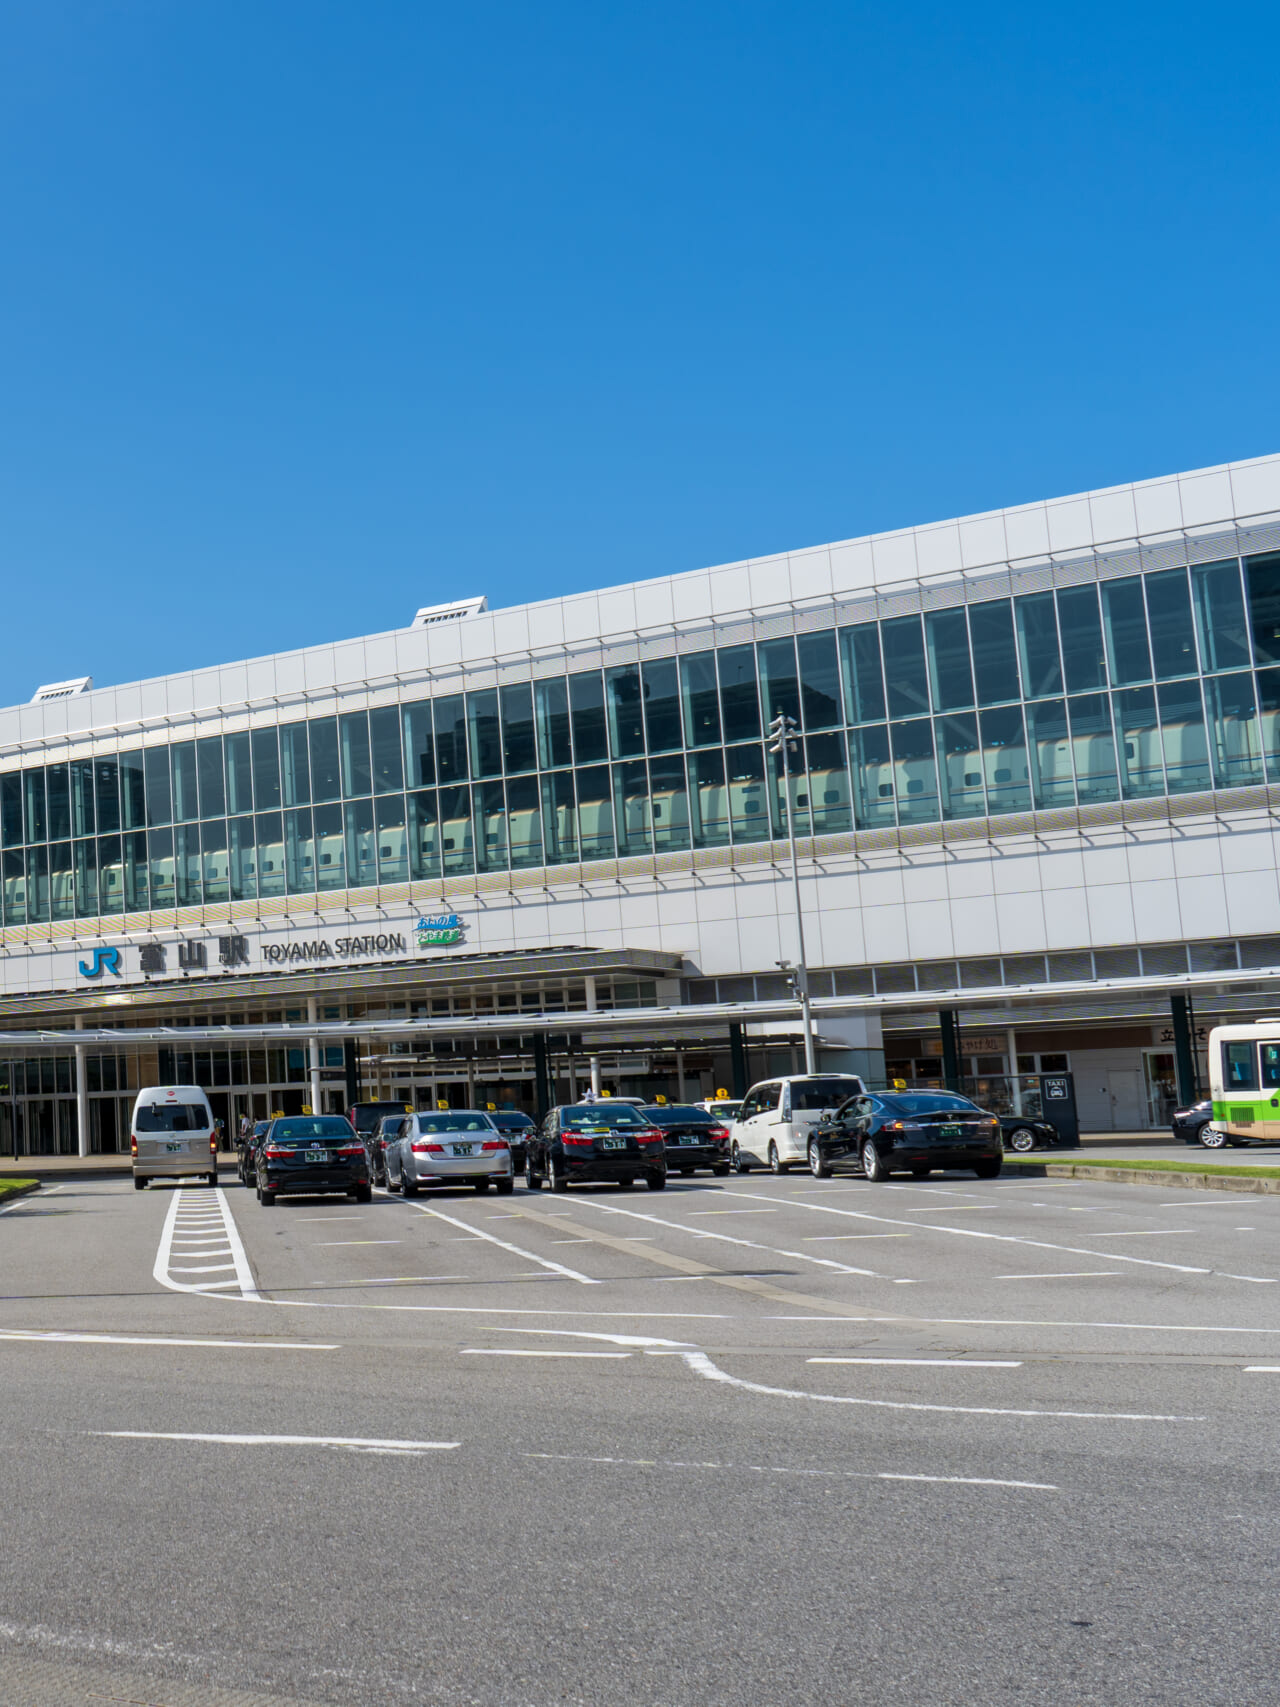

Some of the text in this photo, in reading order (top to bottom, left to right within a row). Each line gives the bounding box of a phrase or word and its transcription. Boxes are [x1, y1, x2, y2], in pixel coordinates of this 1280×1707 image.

[138, 935, 246, 971] 富山駅
[261, 933, 402, 960] TOYAMA STATION
[79, 947, 118, 976] JR
